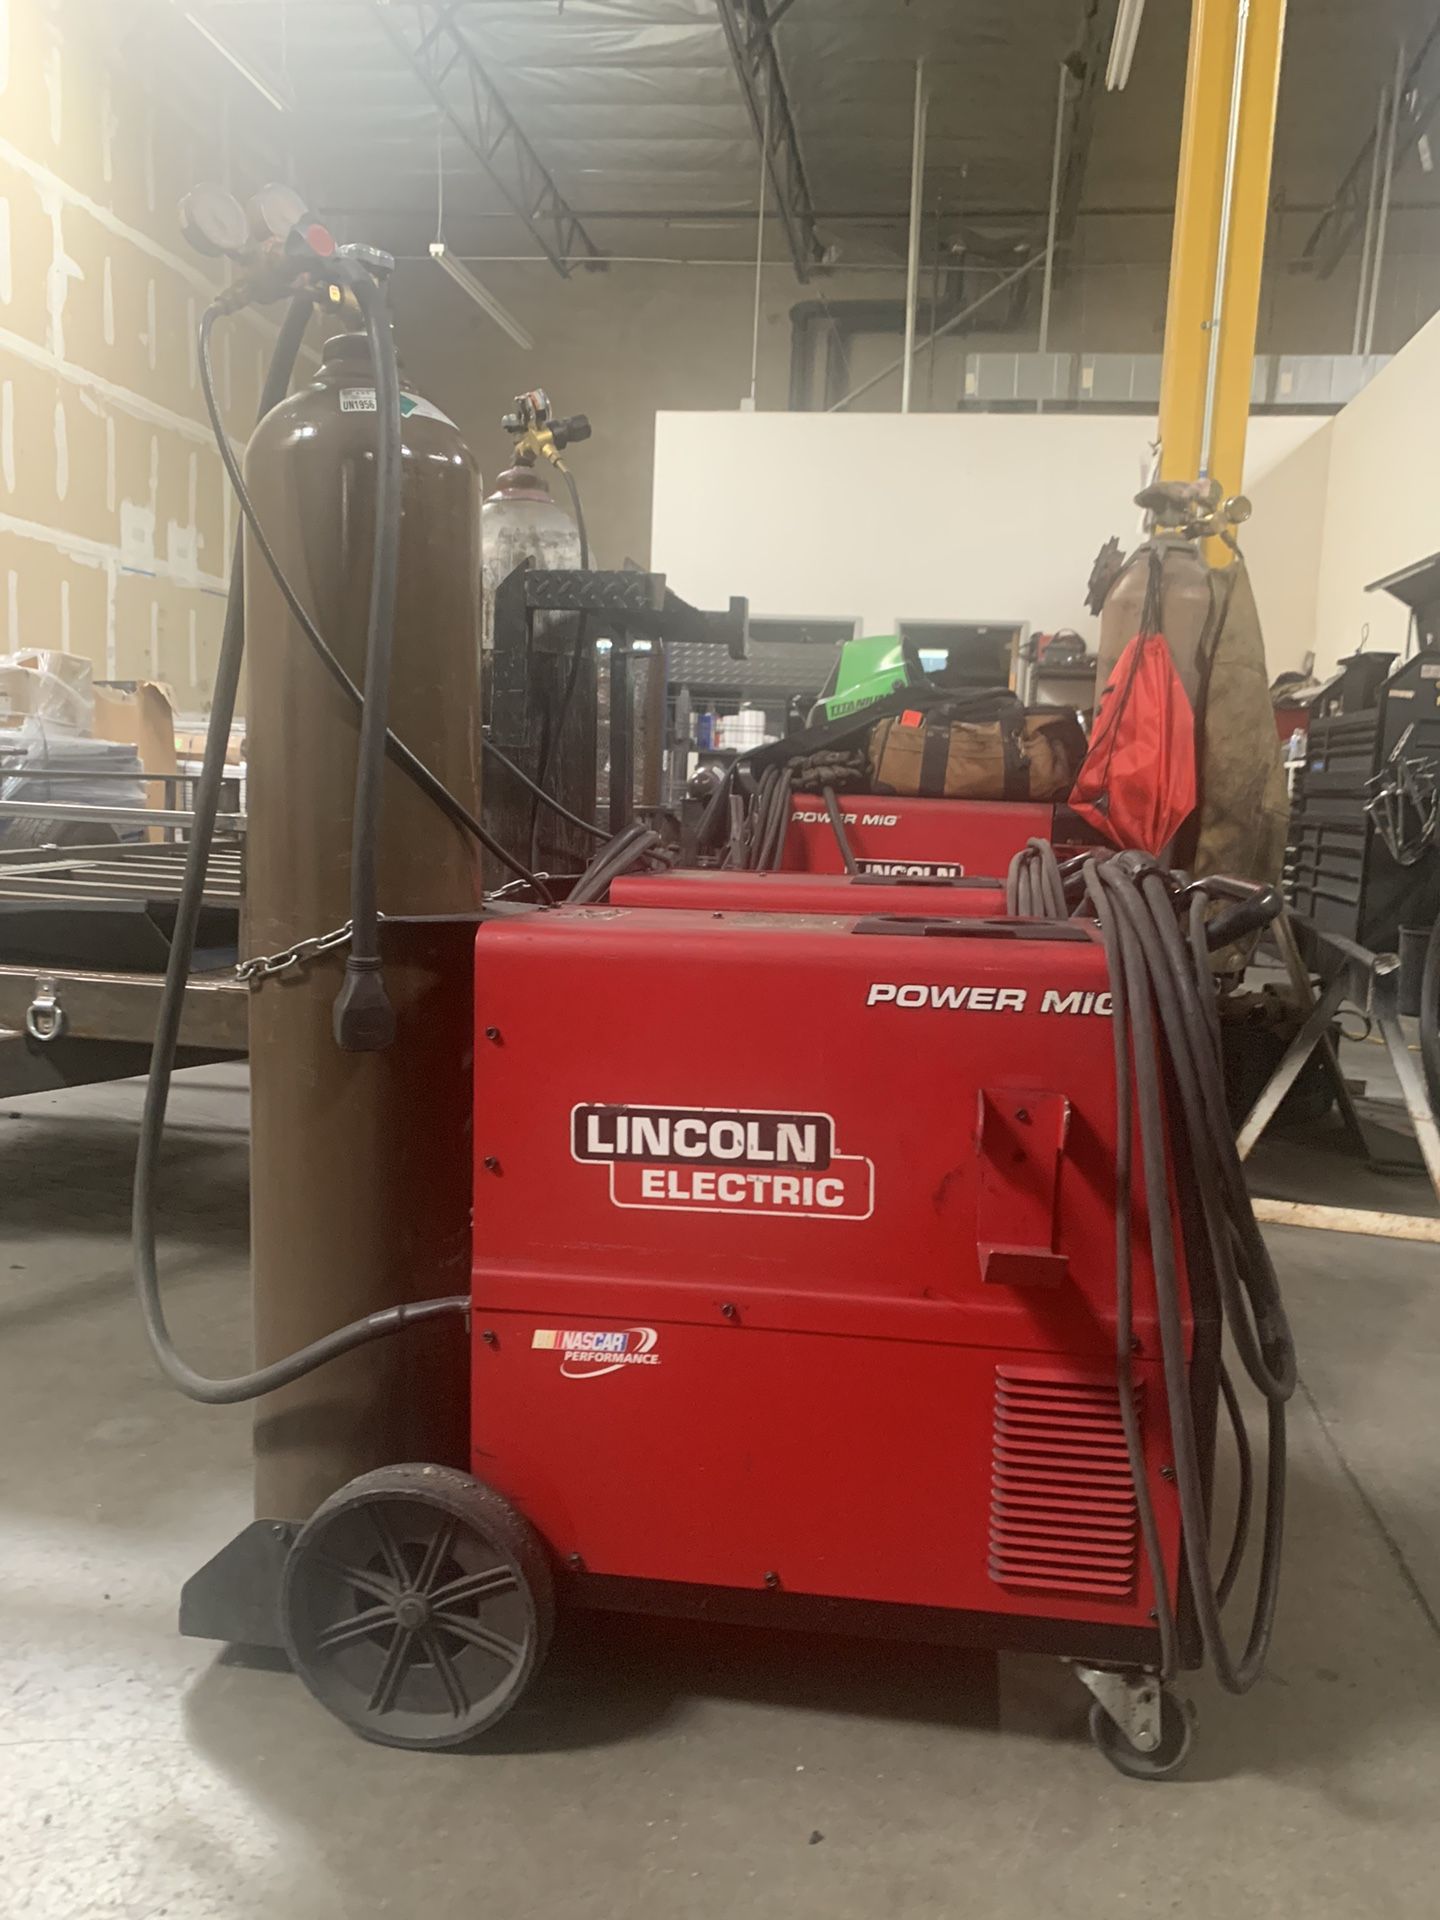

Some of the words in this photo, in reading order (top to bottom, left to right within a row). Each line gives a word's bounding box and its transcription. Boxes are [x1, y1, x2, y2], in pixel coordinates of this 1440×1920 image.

[343, 399, 375, 410] UN1956
[791, 811, 857, 824] POWR
[861, 814, 898, 826] MIG
[855, 864, 957, 878] INCOLN
[866, 983, 1027, 1012] POWER
[587, 1114, 817, 1163] LINCOLN
[641, 1169, 845, 1208] ELECTRIC
[561, 1331, 625, 1352] NASCAR
[564, 1351, 660, 1365] PERFORMANCE
